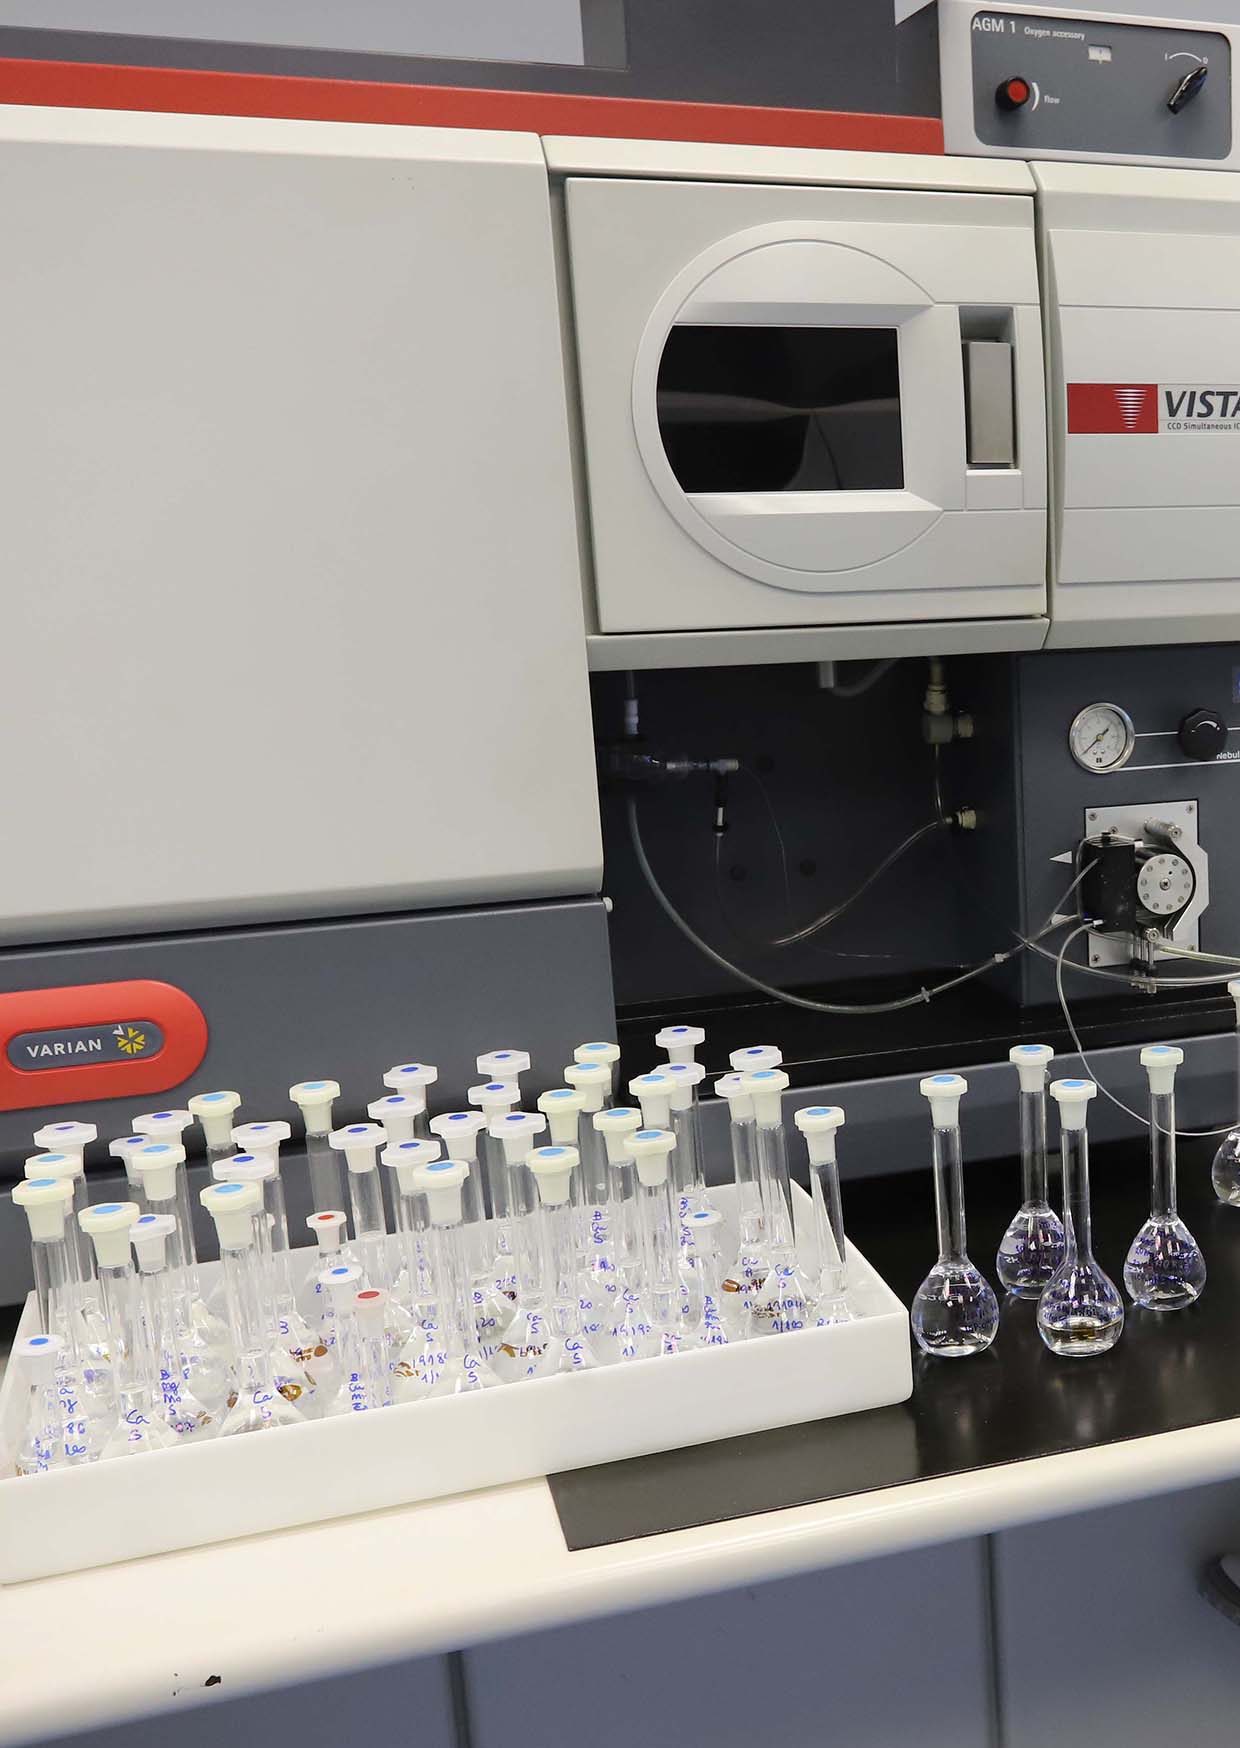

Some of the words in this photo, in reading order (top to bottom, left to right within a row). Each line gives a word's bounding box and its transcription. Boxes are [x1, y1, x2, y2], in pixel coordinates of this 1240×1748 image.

[972, 17, 1004, 33] AGM
[1009, 20, 1017, 34] 1
[1024, 26, 1050, 38] Oxygen
[1052, 29, 1085, 41] accessory
[1044, 94, 1061, 105] flow
[1167, 422, 1182, 431] CCD
[1184, 422, 1232, 431] Simultaneous
[26, 1038, 102, 1058] VARIAN
[421, 1319, 439, 1330] Ca
[564, 1337, 584, 1351] Ca
[252, 1390, 274, 1405] Ca
[125, 1408, 151, 1425] Ca
